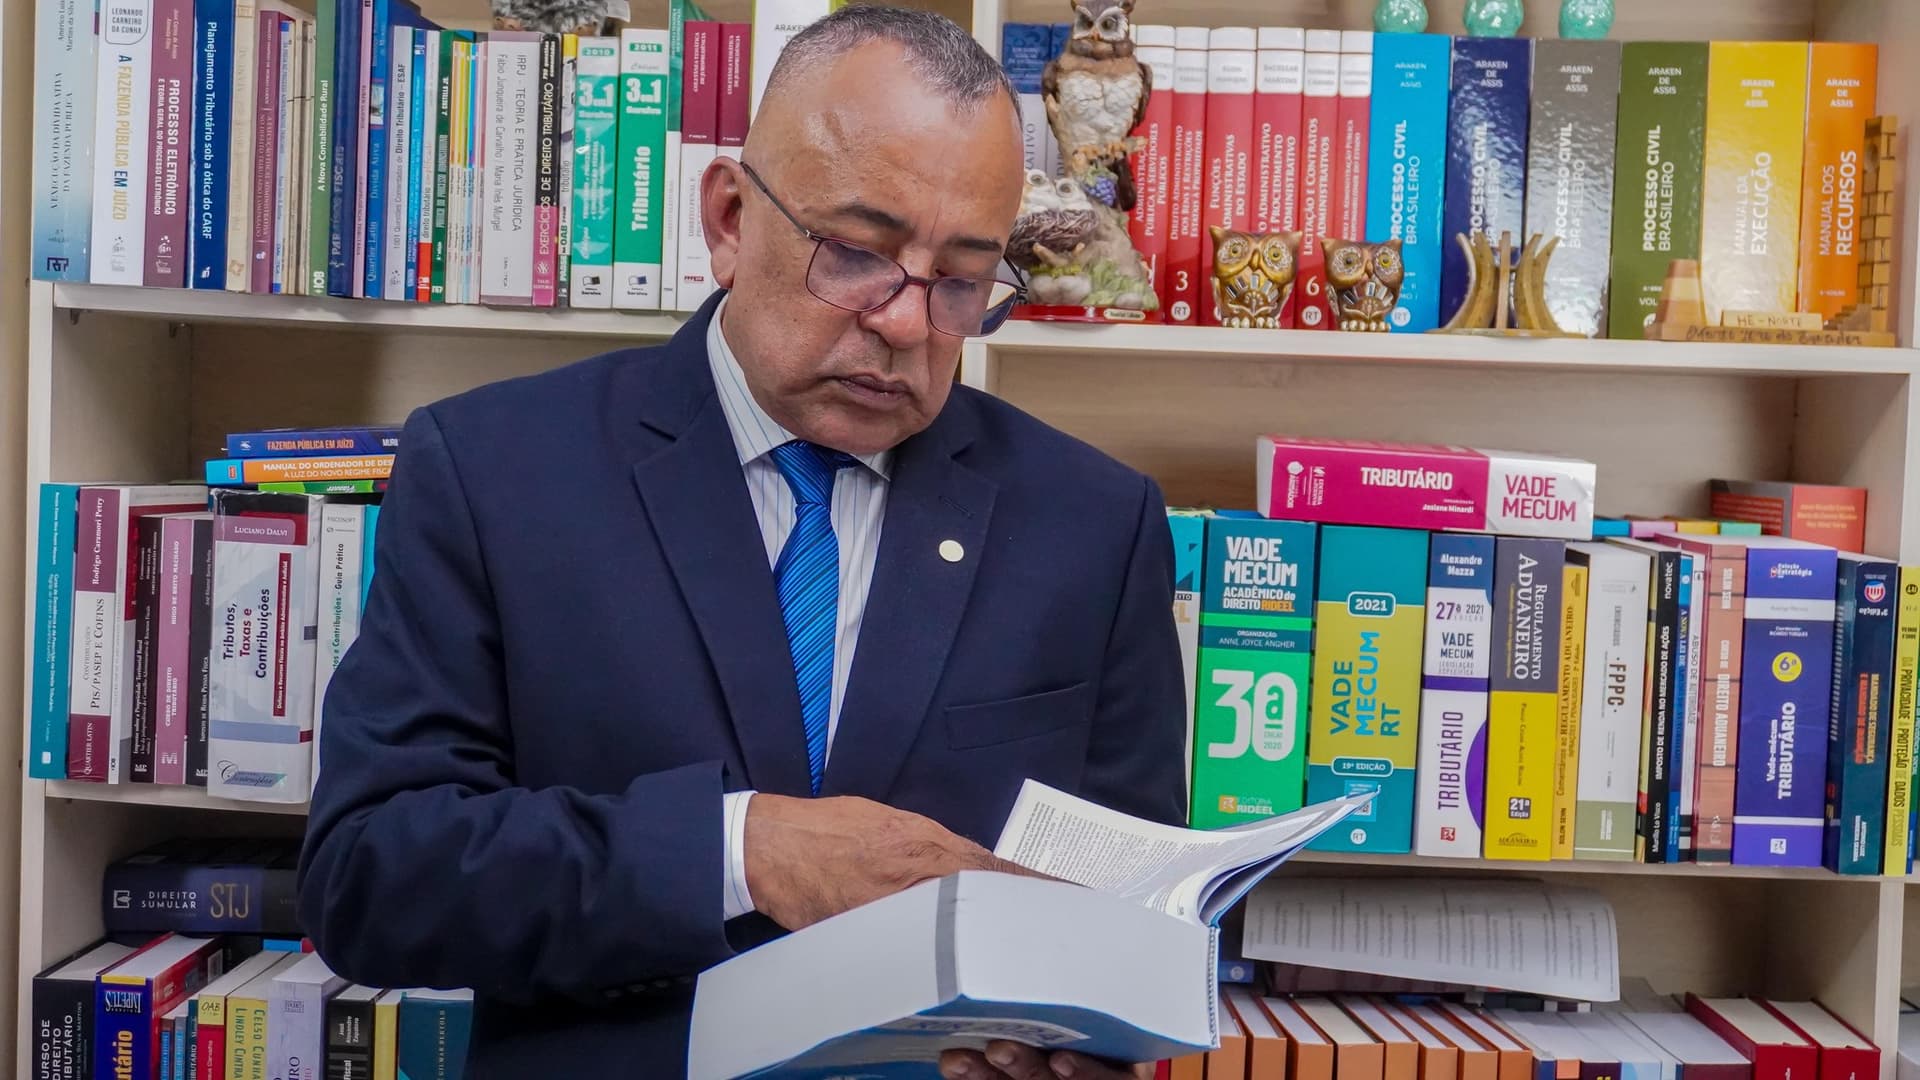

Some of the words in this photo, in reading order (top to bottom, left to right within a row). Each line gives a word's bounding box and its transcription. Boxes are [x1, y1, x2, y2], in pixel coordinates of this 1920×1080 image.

[118, 55, 132, 63] A
[204, 22, 217, 90] Planejamento
[515, 54, 526, 76] IRPJ
[1474, 60, 1508, 70] ARAKEN
[1560, 65, 1593, 75] ARAKEN
[1647, 67, 1682, 76] ARAKEN
[397, 63, 406, 83] ESAF
[1826, 78, 1860, 87] ARAKEN
[116, 66, 133, 117] FAZENDA
[157, 84, 165, 108] TEORIA
[319, 79, 329, 103] Rural
[514, 87, 525, 124] TEORIA
[1653, 86, 1677, 96] ASSIS
[167, 79, 181, 145] PROCESSO
[204, 92, 217, 141] Tributário
[396, 92, 405, 127] Tributário
[539, 83, 554, 136] TRIBUTÁRIO
[115, 120, 133, 167] PÚBLICA
[318, 104, 328, 161] Contabilidade
[395, 128, 404, 154] Direito
[1392, 120, 1407, 159] CIVIL
[1473, 121, 1488, 162] CIVIL
[1558, 122, 1573, 162] CIVIL
[1646, 125, 1661, 166] CIVIL
[155, 141, 163, 175] PROCESSO
[204, 143, 216, 161] sob
[541, 138, 553, 175] DIREITO
[1147, 123, 1158, 184] SERVIDORES
[1306, 117, 1319, 186] CONTRATOS
[114, 170, 129, 188] EM
[164, 148, 180, 215] ELETRÔNICO
[202, 170, 214, 196] ótica
[319, 162, 327, 184] Nova
[541, 177, 552, 191] DE
[1209, 158, 1223, 209] FUNÇÕES
[1236, 152, 1247, 195] ESTADO
[1259, 123, 1271, 219] ADMINISTRATIVO
[1270, 134, 1284, 224] PROCEDIMENTO
[1317, 136, 1331, 238] ADMINISTRATIVOS
[1736, 175, 1749, 194] DA
[1822, 165, 1835, 194] DOS
[153, 176, 163, 215] ELETRÔNICO
[202, 196, 214, 211] do
[319, 184, 326, 192] A
[631, 146, 651, 231] Tributário
[1390, 163, 1405, 240] PROCESSO
[1406, 156, 1420, 245] BRASILEIRO
[1570, 158, 1586, 249] BRASILEIRO
[1749, 152, 1772, 256] EXECUÇÃO
[1836, 150, 1856, 257] RECURSOS
[112, 189, 129, 221] JUÍZO
[1235, 198, 1246, 217] DO
[1556, 166, 1571, 248] PROCESSO
[1643, 169, 1658, 252] PROCESSO
[1659, 161, 1675, 252] BRASILEIRO
[201, 211, 213, 239] CARF
[538, 196, 552, 256] EXERCÍCIOS
[560, 225, 568, 246] OAB
[1303, 197, 1317, 256] LICITAÇÃO
[1733, 197, 1748, 255] MANUAL
[1819, 197, 1834, 256] MANUAL
[367, 244, 378, 282] Quartier
[1175, 271, 1189, 292] 3
[1305, 275, 1320, 296] 6
[1173, 306, 1188, 316] RT
[267, 440, 299, 450] FAZENDA
[299, 438, 325, 450] PÚBLICA
[325, 439, 336, 449] EM
[336, 438, 354, 449] JUÍZO
[263, 461, 297, 471] MANUAL
[298, 461, 312, 470] DO
[312, 460, 364, 469] ORDENADOR
[365, 459, 376, 468] DE
[1360, 466, 1453, 492] TRIBUTÁRIO
[1504, 474, 1557, 499] VADE
[94, 497, 106, 518] Petry
[1501, 497, 1576, 522] MECUM
[93, 518, 104, 554] Caramori
[234, 526, 265, 536] LUCIANO
[266, 527, 289, 537] DALVI
[335, 543, 345, 570] Prático
[1224, 535, 1282, 562] VADE
[1440, 553, 1483, 567] Alexandre
[92, 555, 104, 585] Rodrigo
[334, 571, 344, 590] Guia
[1222, 560, 1298, 587] MECUM
[1446, 566, 1475, 578] Mazza
[1662, 561, 1673, 600] novatec
[1777, 567, 1813, 579] Estratégia
[1222, 585, 1283, 601] ACADÊMICO
[1222, 597, 1259, 611] DIREITO
[1259, 599, 1294, 612] RIDEEL
[1354, 598, 1388, 612] 2021
[1466, 603, 1485, 615] 2021
[93, 598, 105, 640] COFINS
[243, 608, 252, 617] e
[332, 597, 343, 647] Contribuições
[1513, 552, 1540, 680] ADUANEIRO
[222, 602, 239, 661] Tributos,
[239, 620, 252, 658] Taxas
[255, 588, 273, 679] Contribuições
[1441, 631, 1475, 648] VADE
[1531, 583, 1548, 680] REGULAMENTO
[1659, 624, 1671, 651] AÇÕES
[1440, 647, 1475, 660] MECUM
[1660, 650, 1669, 662] DE
[1690, 634, 1700, 667] ABUSO
[90, 652, 103, 710] PIS/PASEP
[1354, 631, 1381, 736] MECUM
[1607, 662, 1628, 707] FPPC
[1658, 662, 1669, 698] MERCADO
[1690, 667, 1699, 681] DE
[1329, 660, 1354, 736] VADE
[1558, 664, 1571, 736] REGULAMENTO
[1658, 698, 1667, 711] NO
[1714, 673, 1732, 712] DIREITO
[1868, 673, 1880, 711] MANDADO
[1897, 667, 1913, 720] PRIVACIDADE
[85, 723, 95, 742] LATIN
[1380, 702, 1401, 738] RT
[1657, 710, 1667, 737] RENDA
[1263, 741, 1284, 750] 2020
[1656, 737, 1666, 751] DE
[1712, 712, 1730, 767] ADUANEIRO
[1766, 719, 1778, 783] Vade-mécum
[1777, 701, 1797, 800] TRIBUTÁRIO
[1894, 727, 1912, 769] PROTEÇÃO
[83, 742, 94, 776] QUARTIER
[1355, 762, 1386, 772] EDIÇÃO
[1436, 711, 1464, 811] TRIBUTÁRIO
[1555, 749, 1567, 797] Comentários
[1655, 751, 1665, 780] IMPOSTO
[1236, 804, 1276, 816] RIDEEL
[1510, 798, 1531, 811] 21ª
[1892, 780, 1907, 808] DADOS
[1352, 833, 1365, 841] RT
[141, 900, 197, 909] SUMULAR
[148, 890, 197, 900] DIREITO
[209, 883, 250, 919] STJ
[105, 990, 142, 1014] IMPETUS
[42, 1019, 50, 1037] DE
[233, 1007, 247, 1045] LINDLEY
[253, 1008, 266, 1040] CELSO
[345, 1015, 354, 1044] Alexandre
[52, 1027, 61, 1080] DIREITO
[233, 1048, 247, 1079] CINTRA
[252, 1045, 266, 1080] CUNHA
